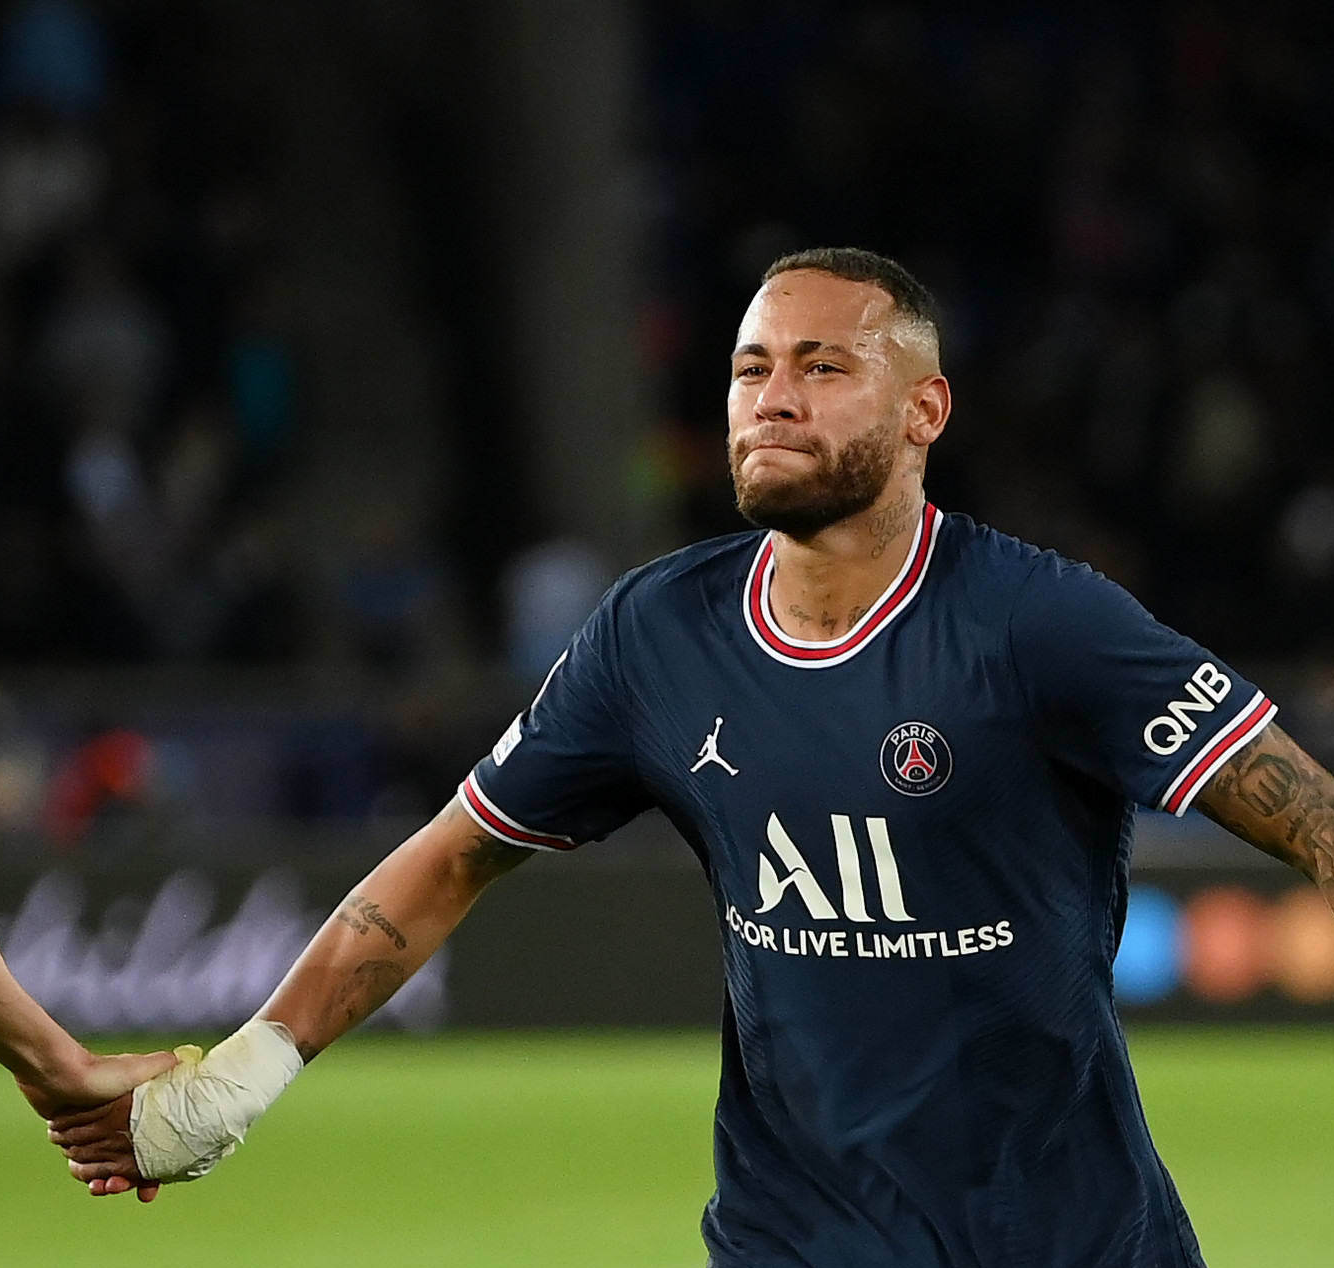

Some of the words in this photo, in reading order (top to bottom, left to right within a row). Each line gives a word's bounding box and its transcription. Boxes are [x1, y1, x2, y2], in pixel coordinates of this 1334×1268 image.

[1143, 662, 1232, 755] QNB
[890, 725, 936, 746] PARIS
[783, 928, 849, 957] LIVE
[855, 920, 1014, 958] LIMITLESS
